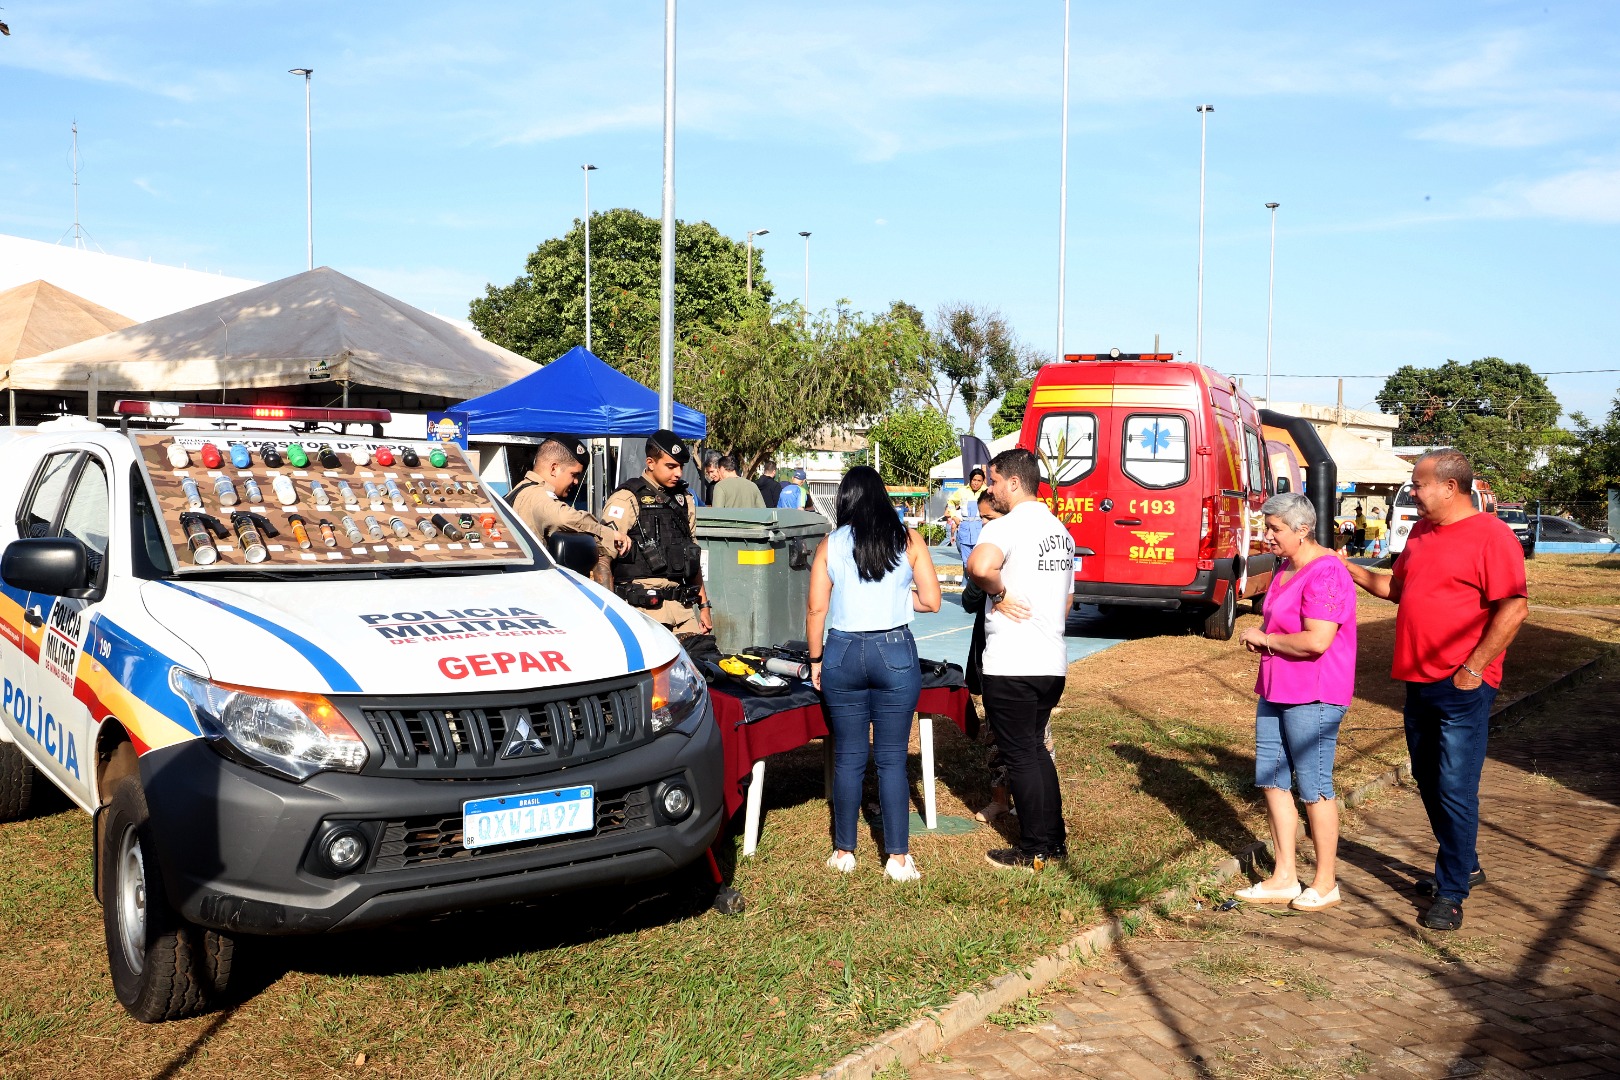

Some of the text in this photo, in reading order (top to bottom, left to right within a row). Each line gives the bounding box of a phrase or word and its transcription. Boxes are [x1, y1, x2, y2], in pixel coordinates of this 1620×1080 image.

[1036, 497, 1094, 512] SGATE
[1139, 499, 1176, 515] 193
[1128, 545, 1175, 560] SIATE
[374, 618, 559, 639] MILITAR
[389, 628, 568, 646] DE MINAS GERAIS
[45, 632, 76, 676] MILITAR
[99, 637, 112, 659] 190
[437, 650, 572, 680] GEPAR
[519, 798, 541, 807] BRASIL
[478, 802, 581, 842] QXW1A97
[466, 836, 475, 845] BR
